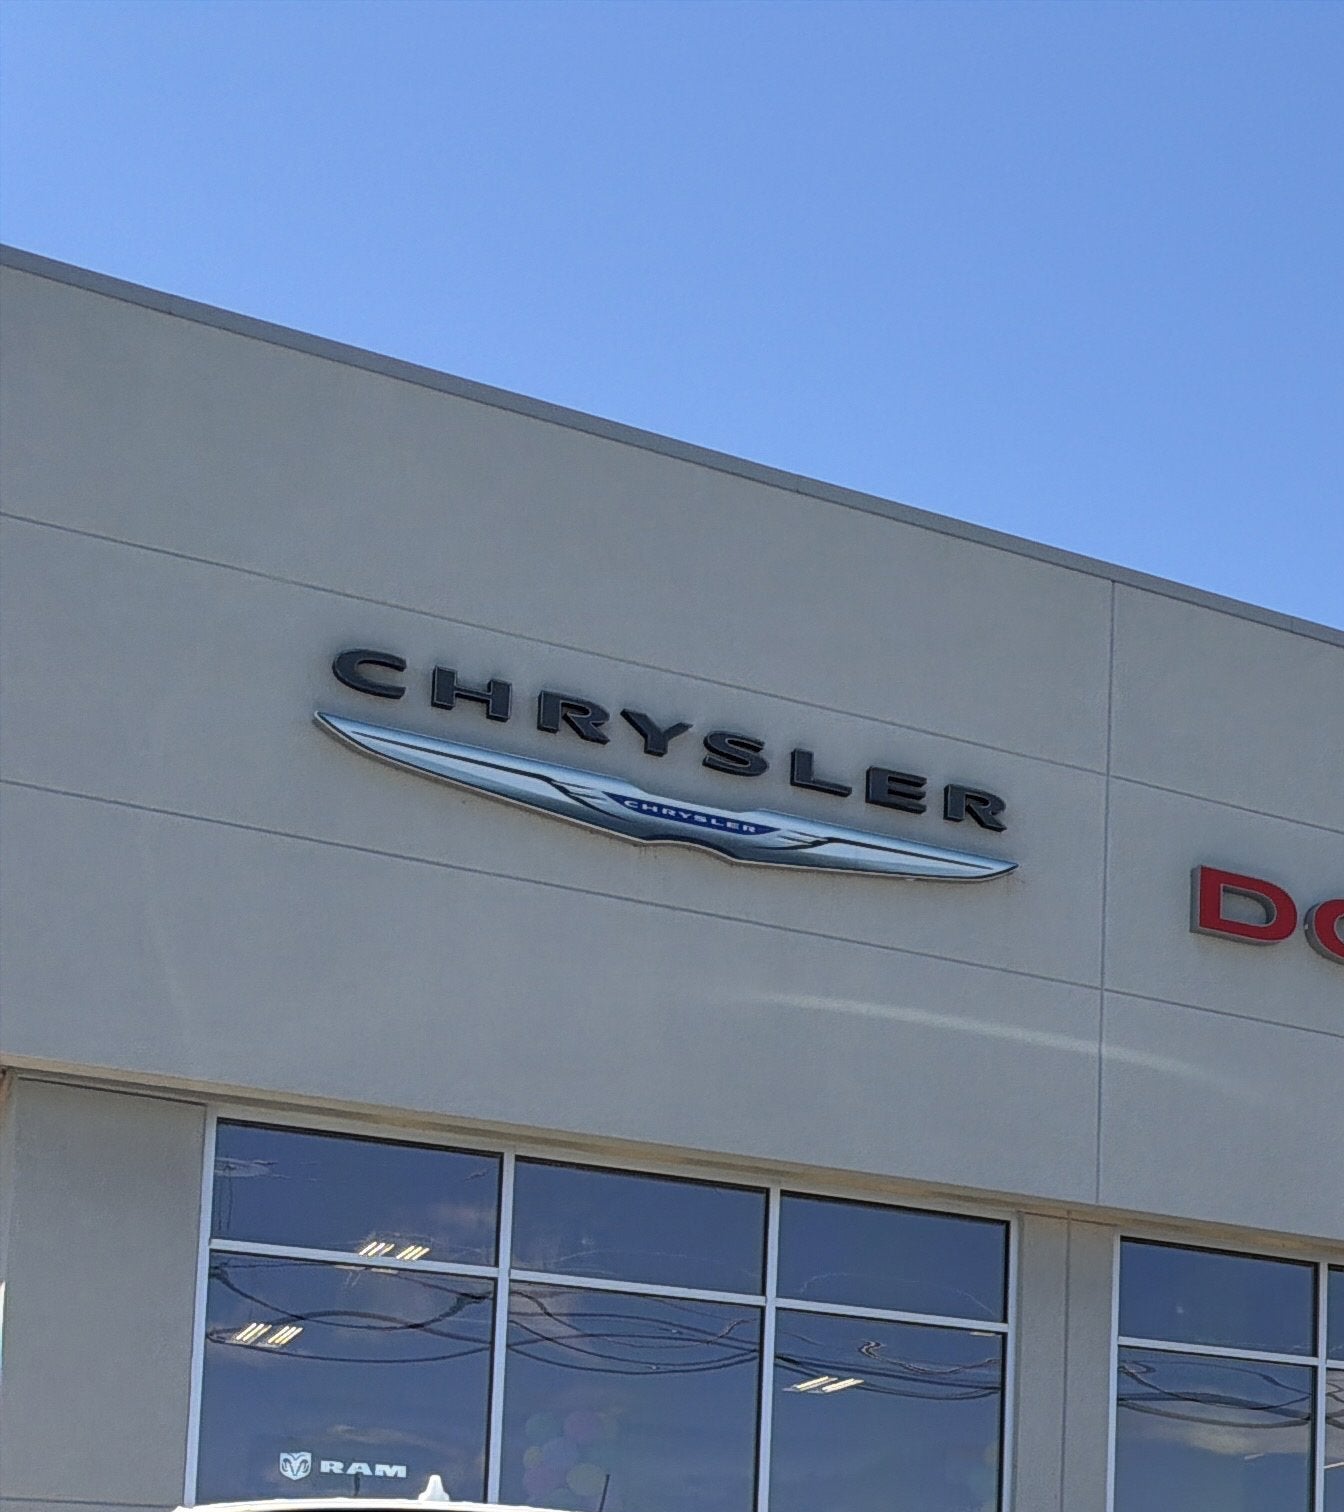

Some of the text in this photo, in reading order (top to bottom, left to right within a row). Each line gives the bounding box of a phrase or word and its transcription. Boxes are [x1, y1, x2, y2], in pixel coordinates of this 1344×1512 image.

[331, 647, 1008, 833] CHRYSLER
[623, 800, 757, 833] CHRYSLER
[319, 1458, 407, 1479] RAM
